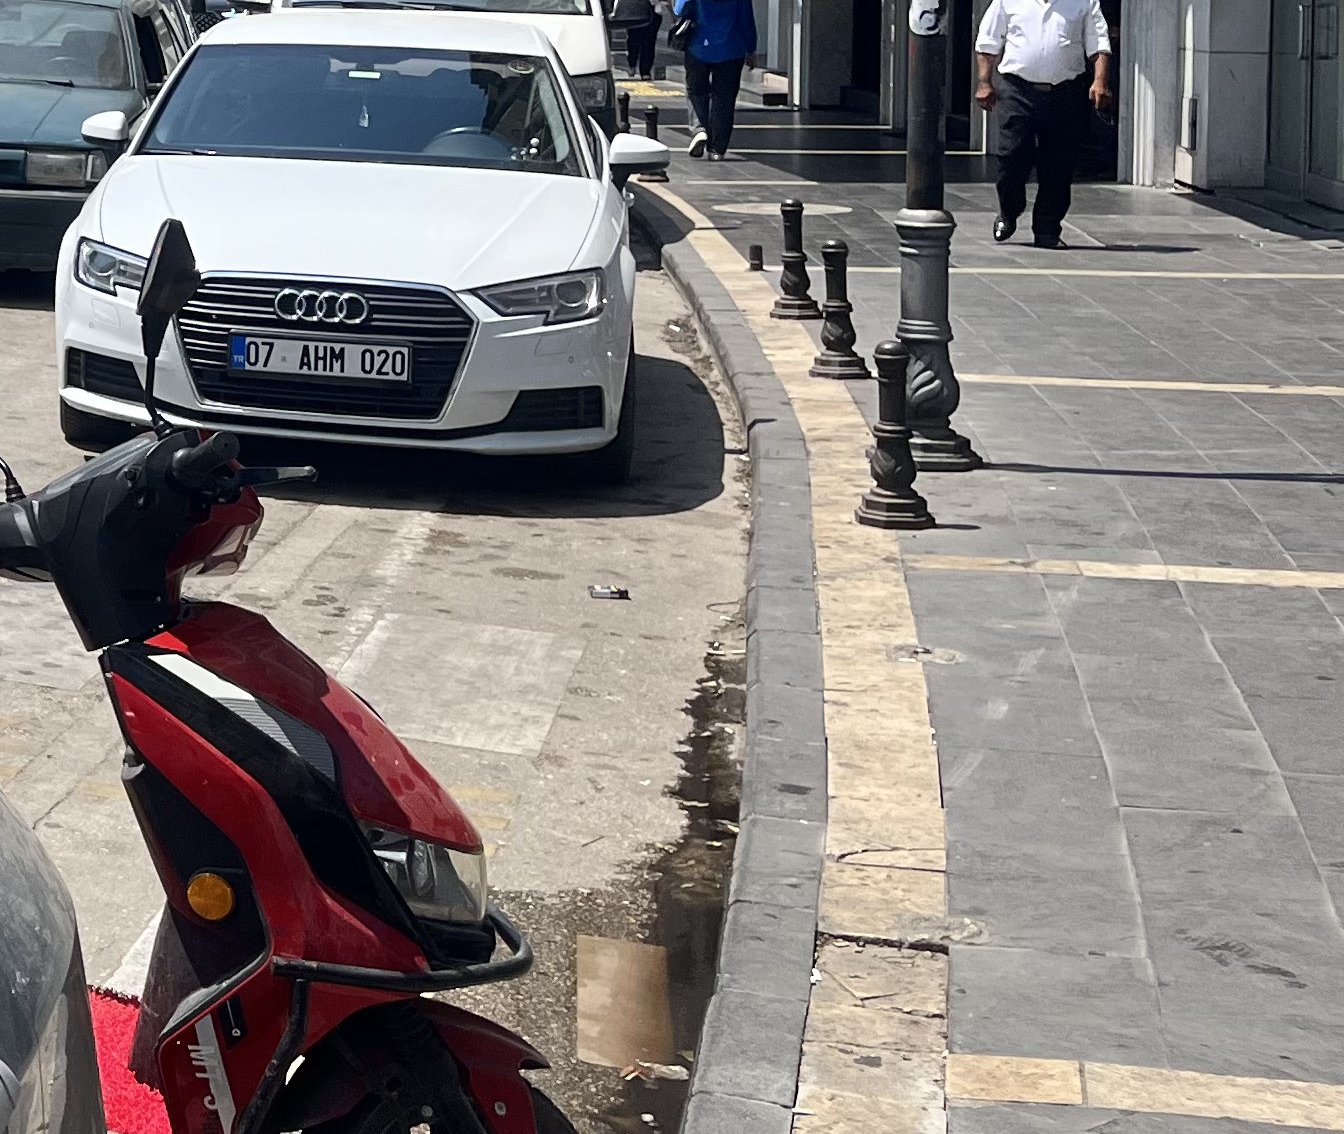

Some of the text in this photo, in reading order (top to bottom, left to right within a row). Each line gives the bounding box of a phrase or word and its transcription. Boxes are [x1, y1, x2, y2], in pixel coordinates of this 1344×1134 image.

[246, 341, 275, 368] 07
[298, 344, 346, 374] AHM
[360, 348, 406, 377] 020
